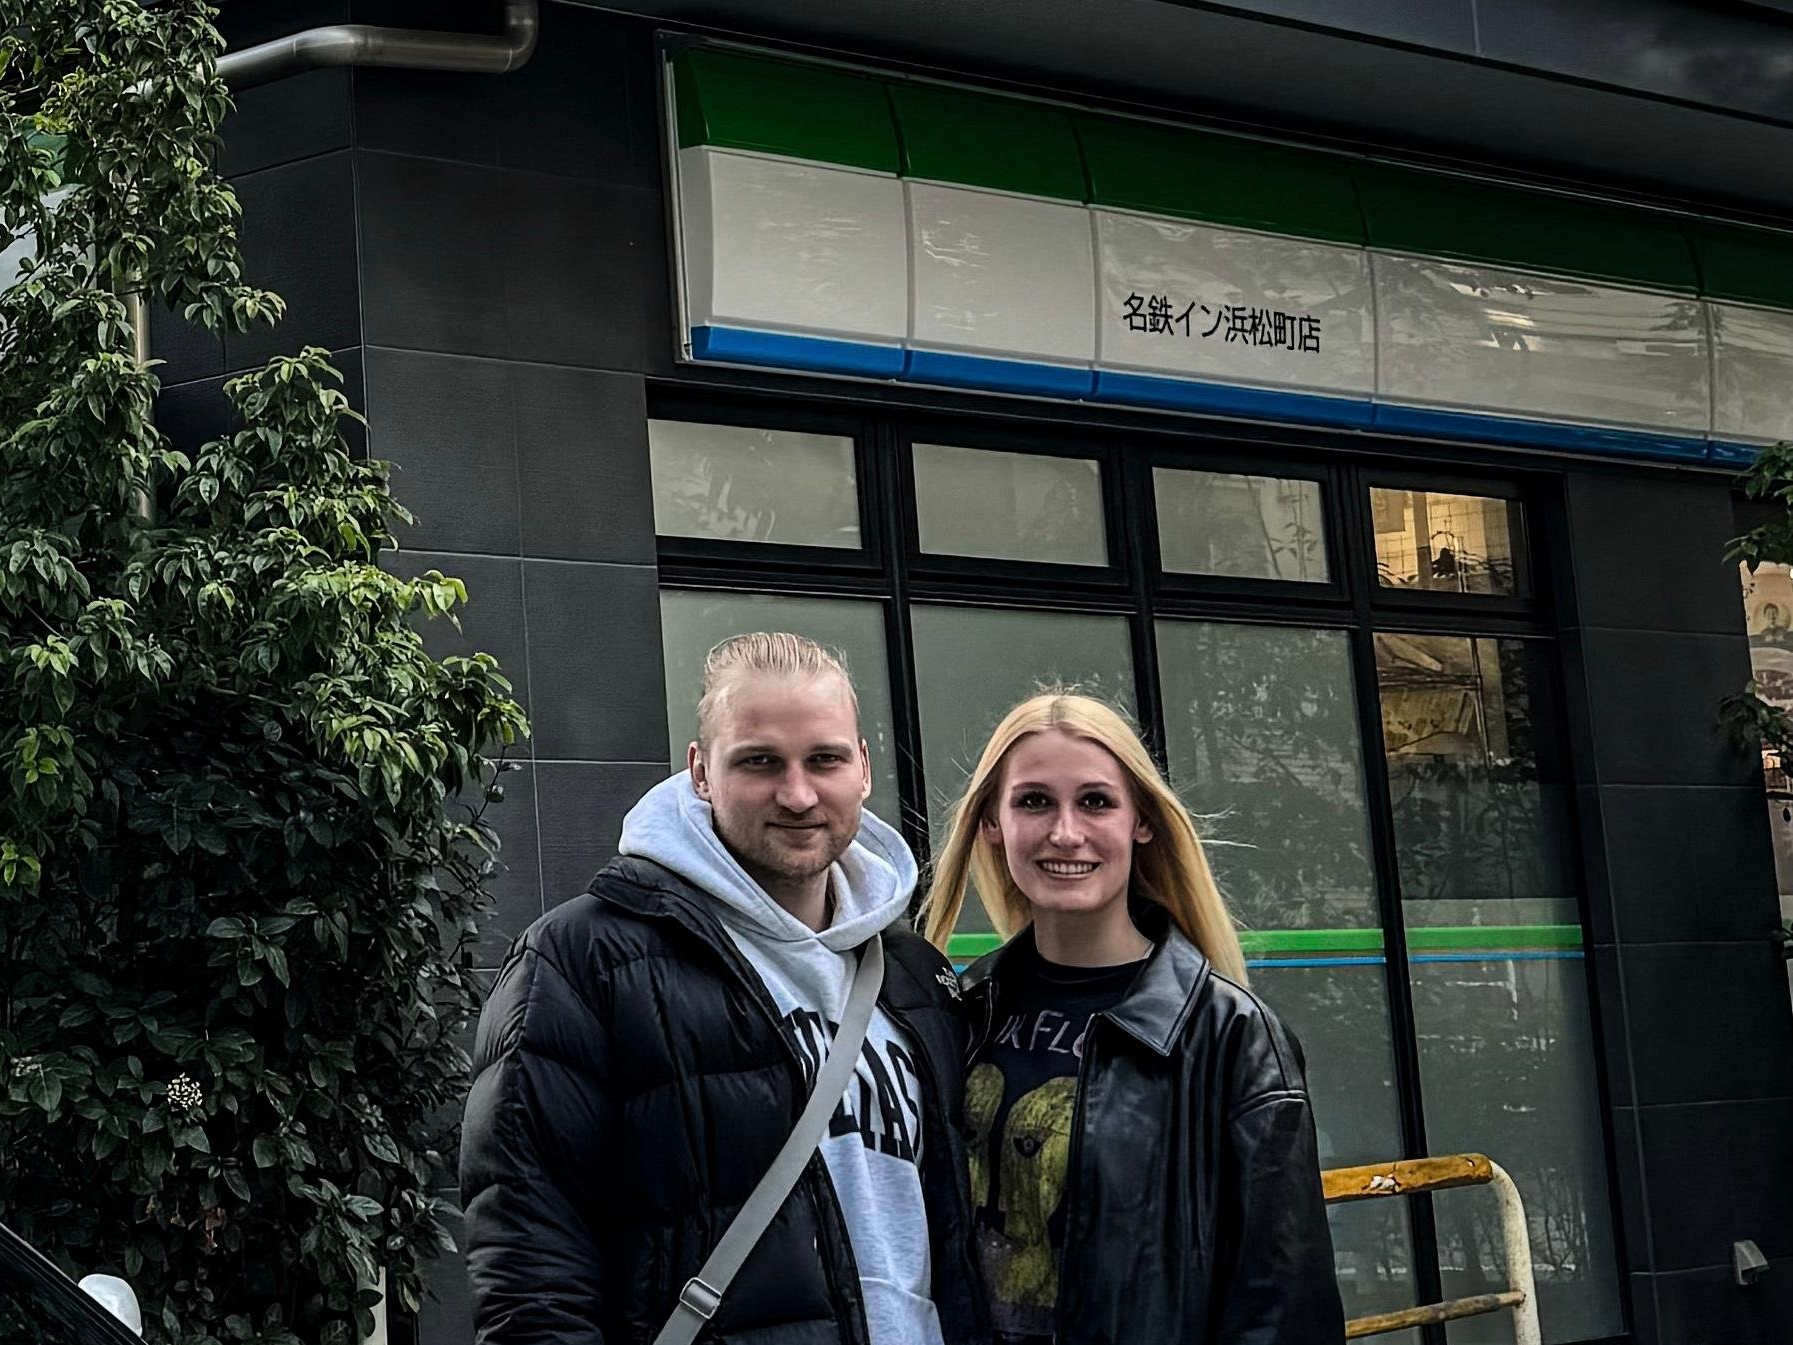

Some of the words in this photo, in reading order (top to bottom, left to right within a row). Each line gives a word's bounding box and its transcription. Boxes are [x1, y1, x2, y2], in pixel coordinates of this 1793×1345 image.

[1123, 292, 1321, 353] 名鉄イン浜松町店
